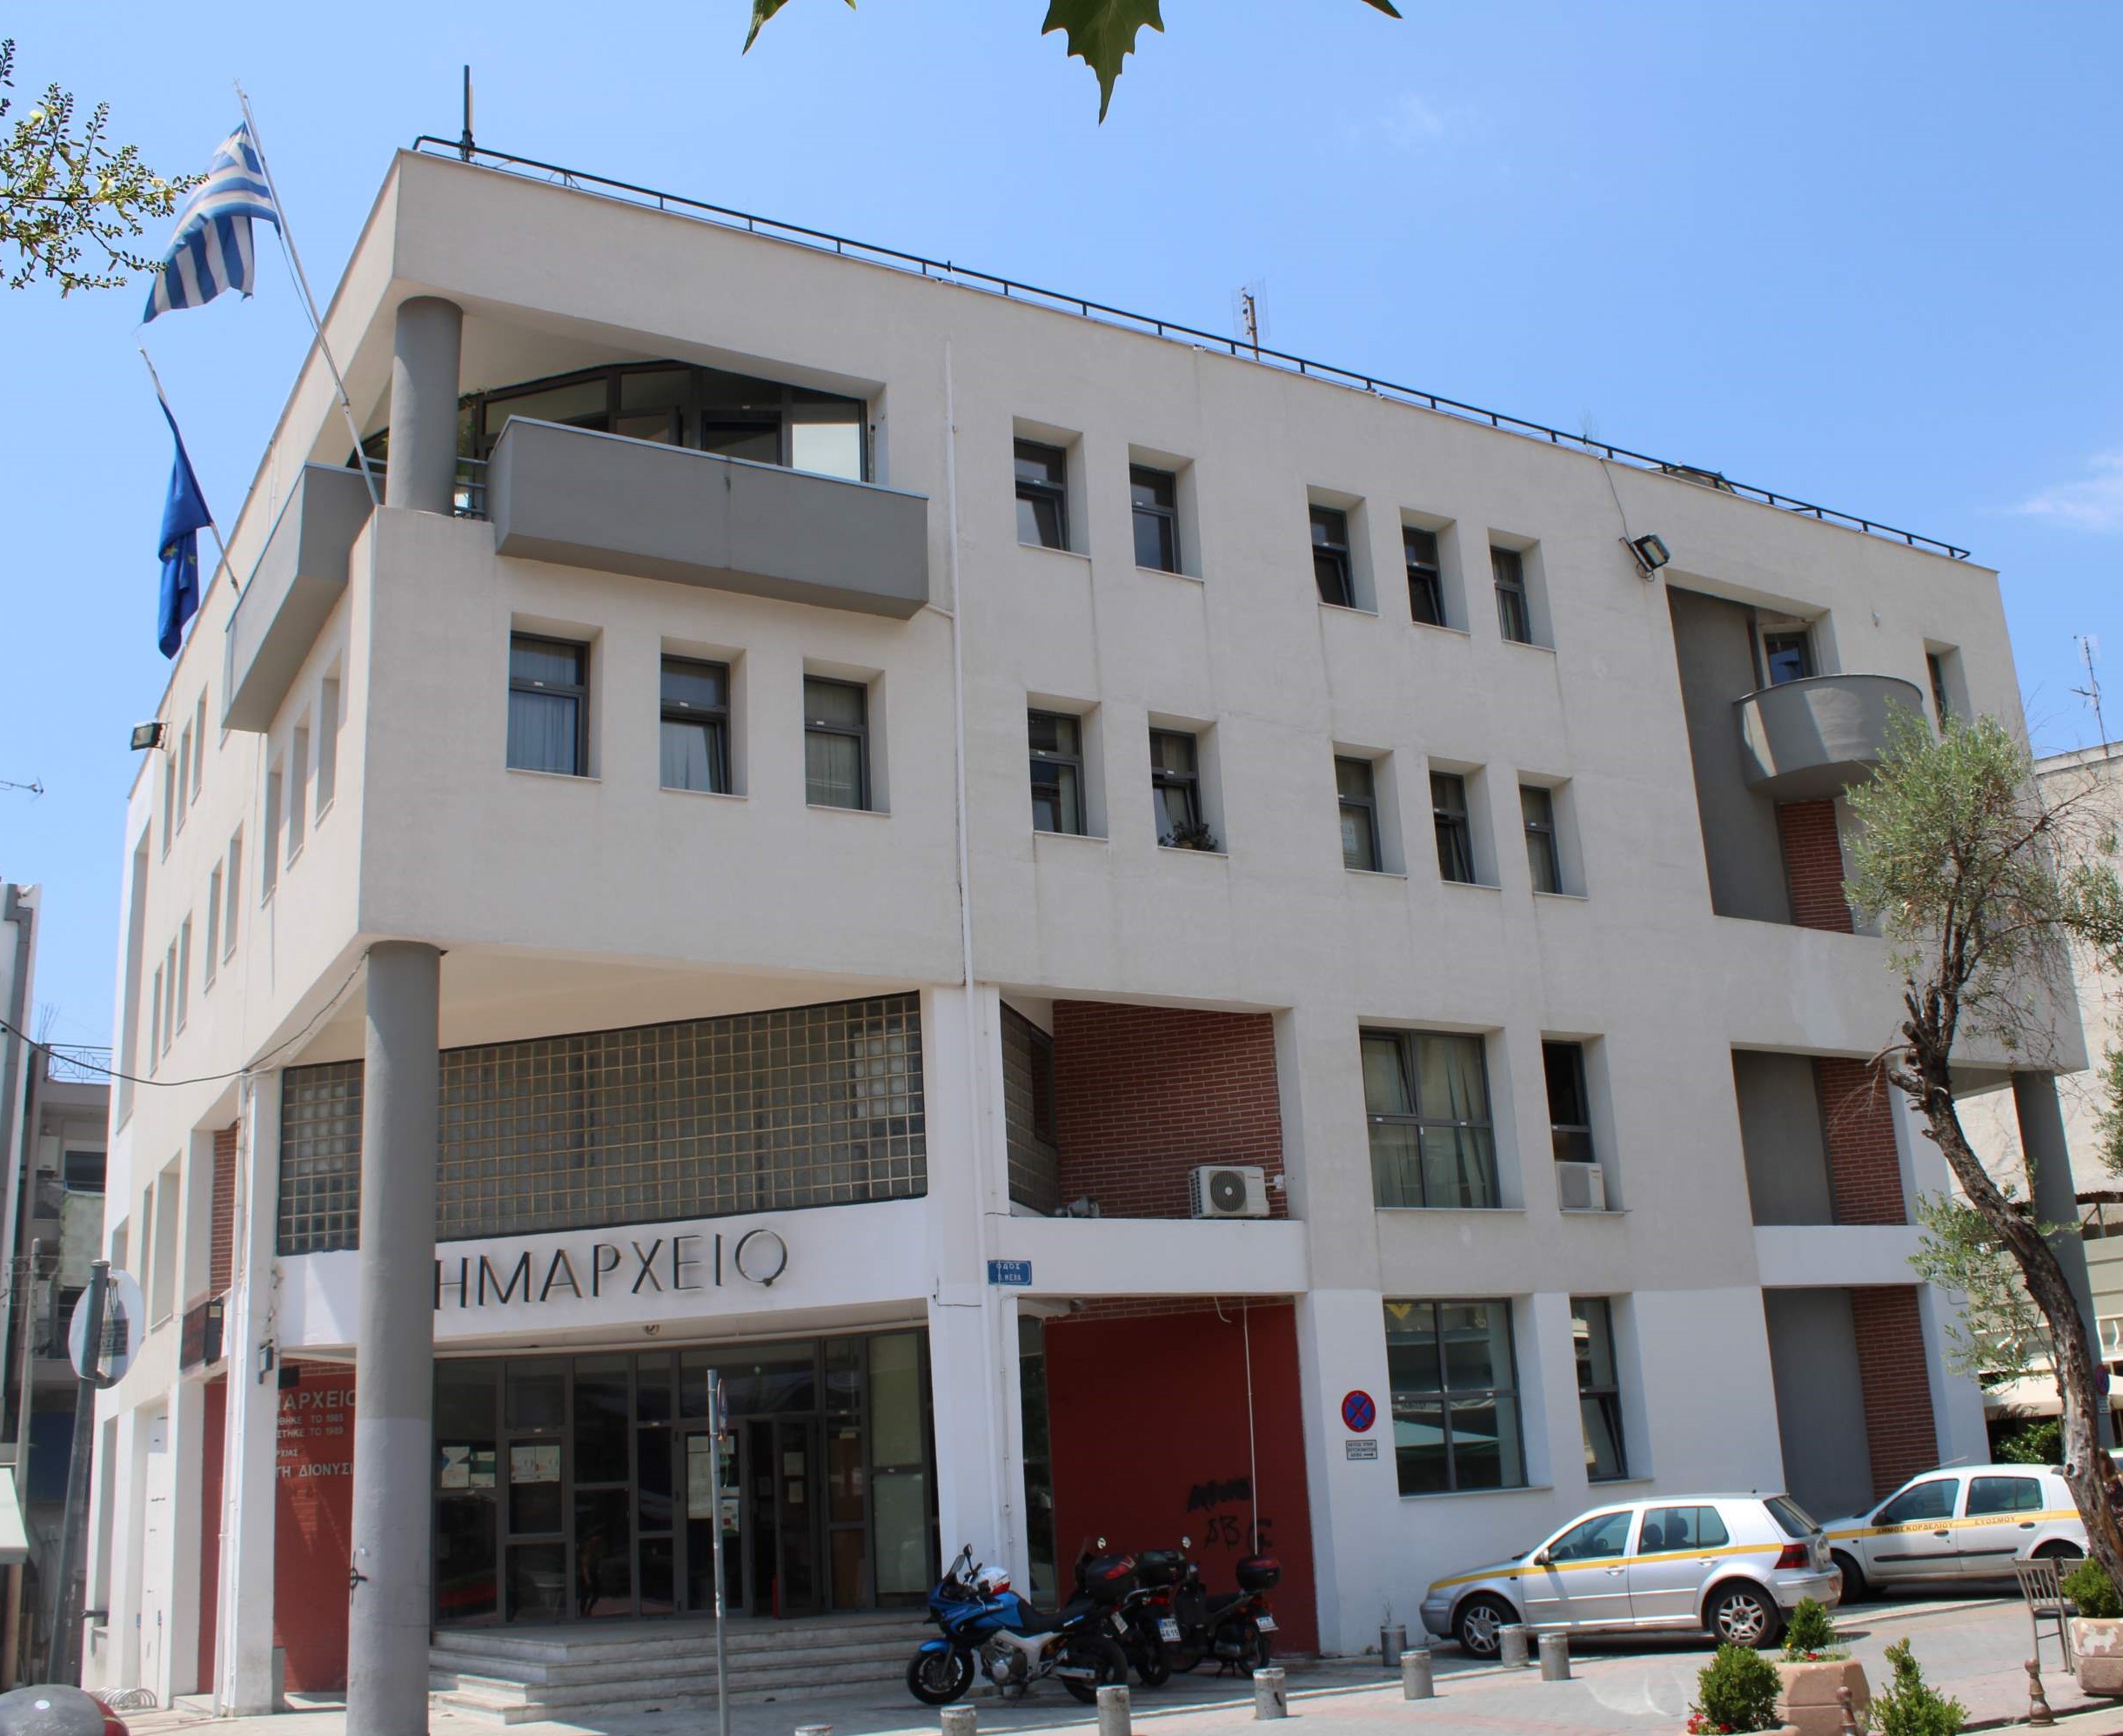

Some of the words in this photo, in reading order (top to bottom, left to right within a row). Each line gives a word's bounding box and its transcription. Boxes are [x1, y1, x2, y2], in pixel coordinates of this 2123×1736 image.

[434, 1229, 788, 1310] ΗΜΑΡΧΕΙΟ
[278, 1390, 355, 1411] ΑΡΧΕΙΟ
[298, 1462, 354, 1478] ΔΙΟΝΥΣΙ
[1905, 1522, 1953, 1532] ΚΟΡΔΕΛΙΟΥ
